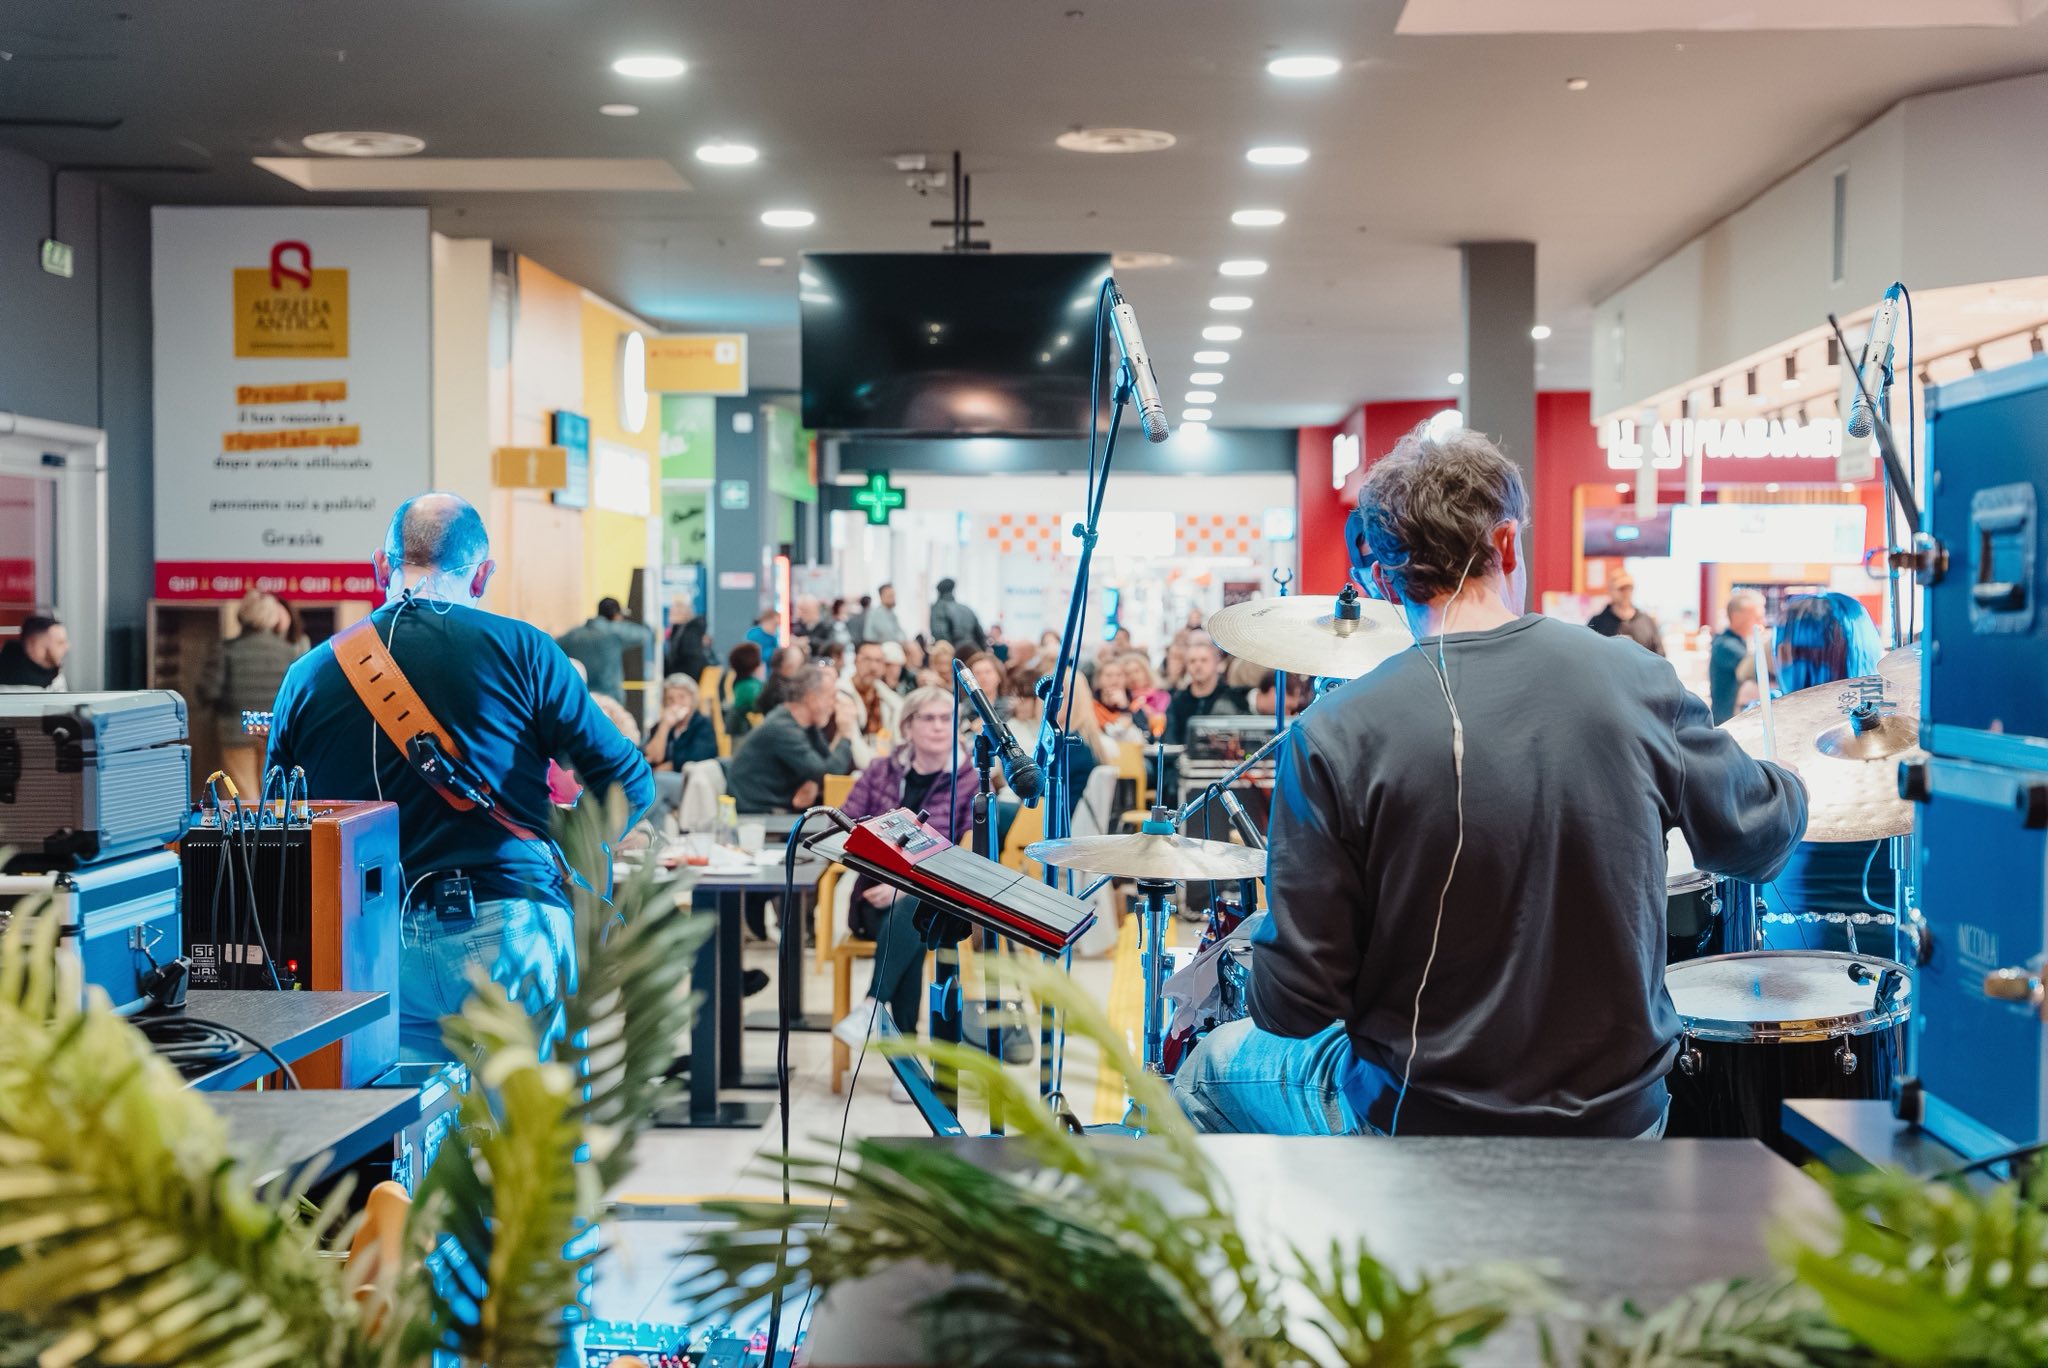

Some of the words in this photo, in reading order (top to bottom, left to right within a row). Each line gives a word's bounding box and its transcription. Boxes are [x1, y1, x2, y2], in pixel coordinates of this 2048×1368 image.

[254, 315, 330, 331] ANTICA
[262, 528, 324, 547] Grazie
[211, 575, 243, 593] QUI
[255, 576, 287, 593] QUI
[300, 576, 331, 593] QUI
[343, 576, 375, 593] QUI
